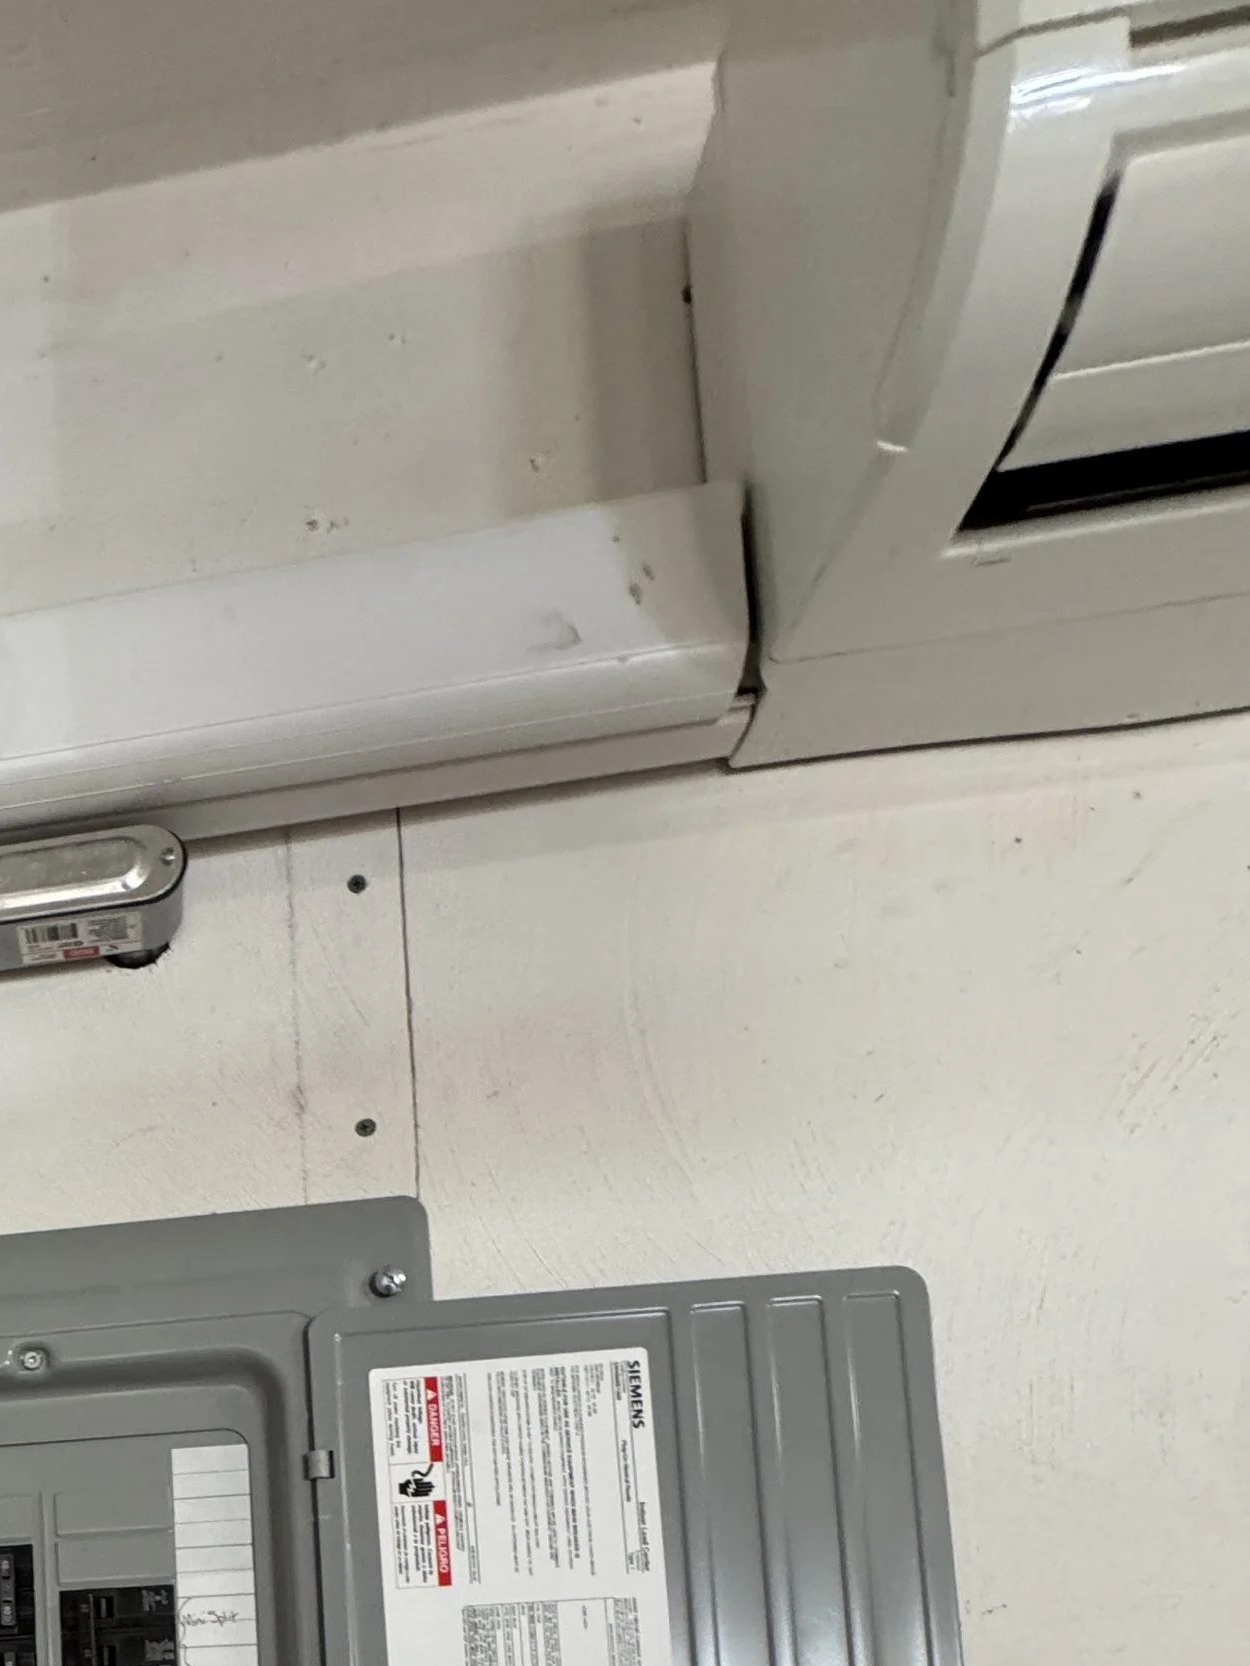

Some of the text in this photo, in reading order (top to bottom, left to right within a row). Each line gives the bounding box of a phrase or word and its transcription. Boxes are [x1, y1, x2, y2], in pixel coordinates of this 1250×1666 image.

[628, 1360, 644, 1429] SIEMENS
[428, 1404, 439, 1446] DANGER
[437, 1528, 448, 1573] PELIGRO
